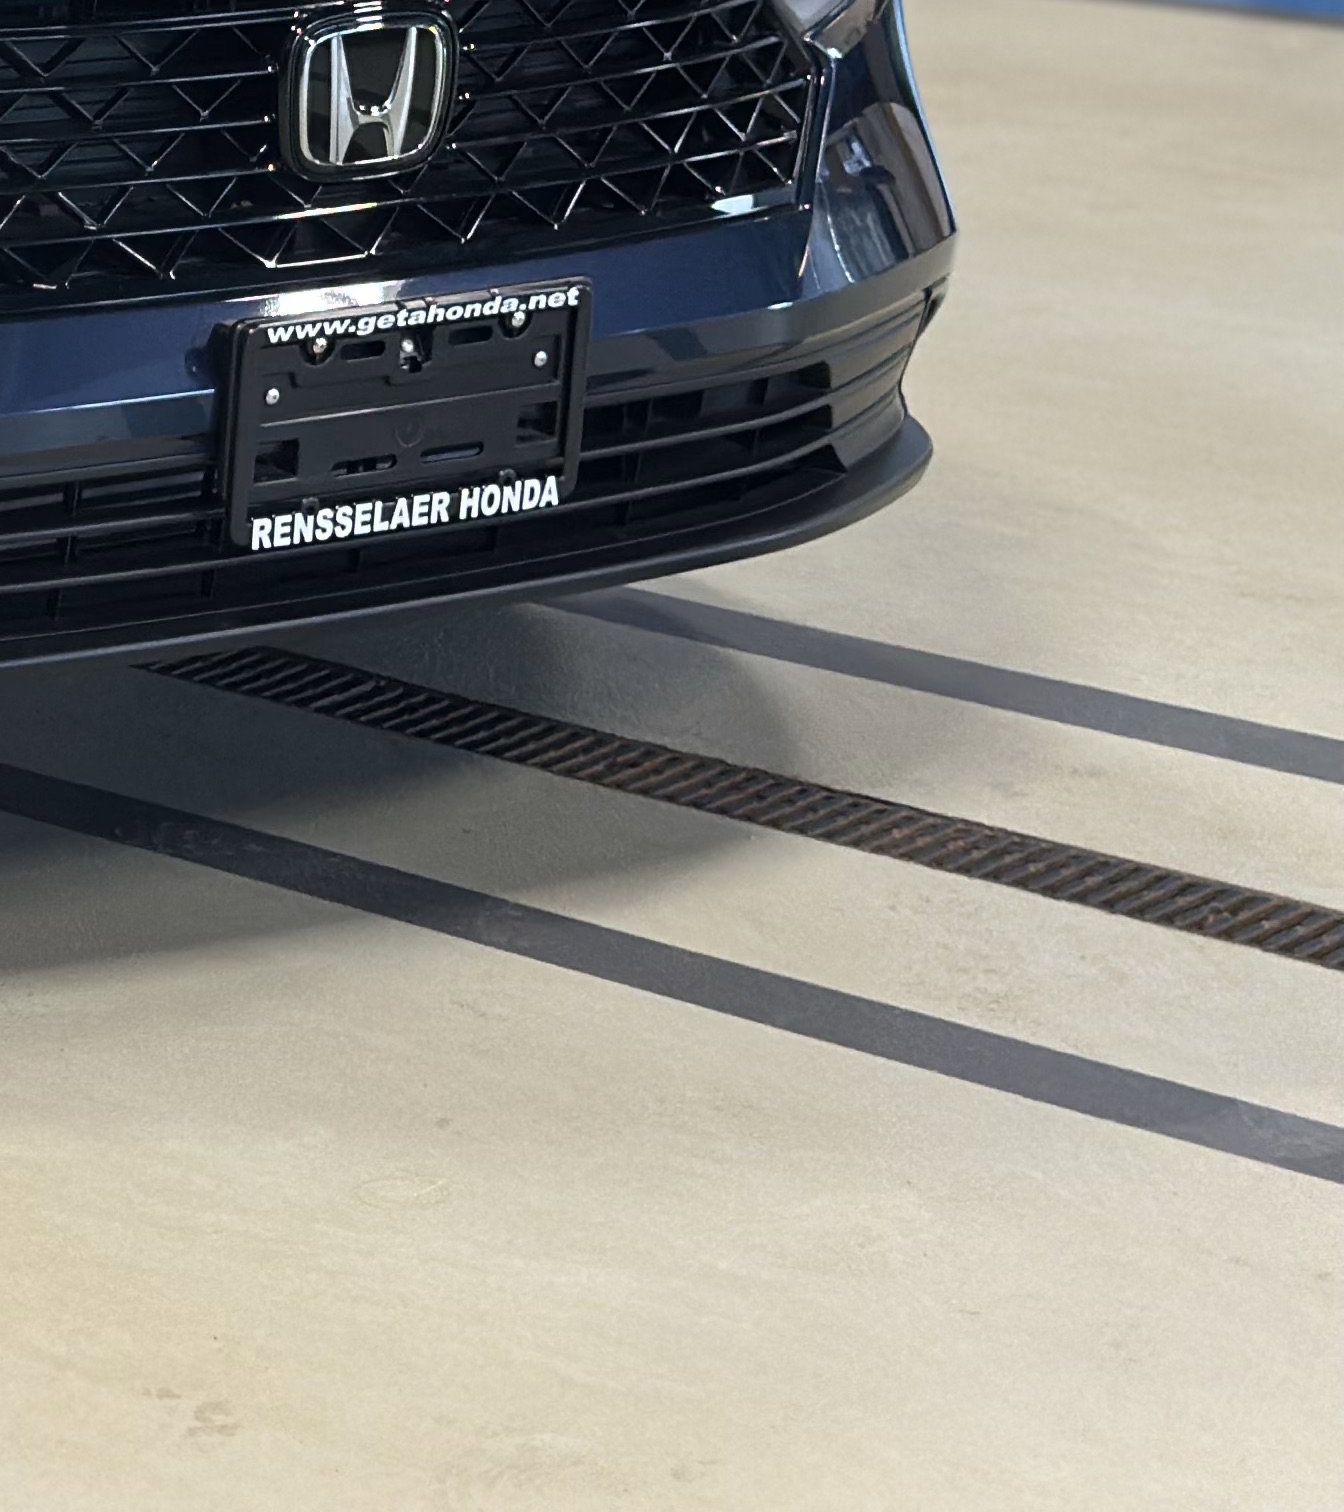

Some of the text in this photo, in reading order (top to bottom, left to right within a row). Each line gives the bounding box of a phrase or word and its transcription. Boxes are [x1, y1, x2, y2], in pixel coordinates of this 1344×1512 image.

[267, 287, 580, 344] www.getahonda.net
[251, 475, 559, 551] RENSSELAER HONDA
